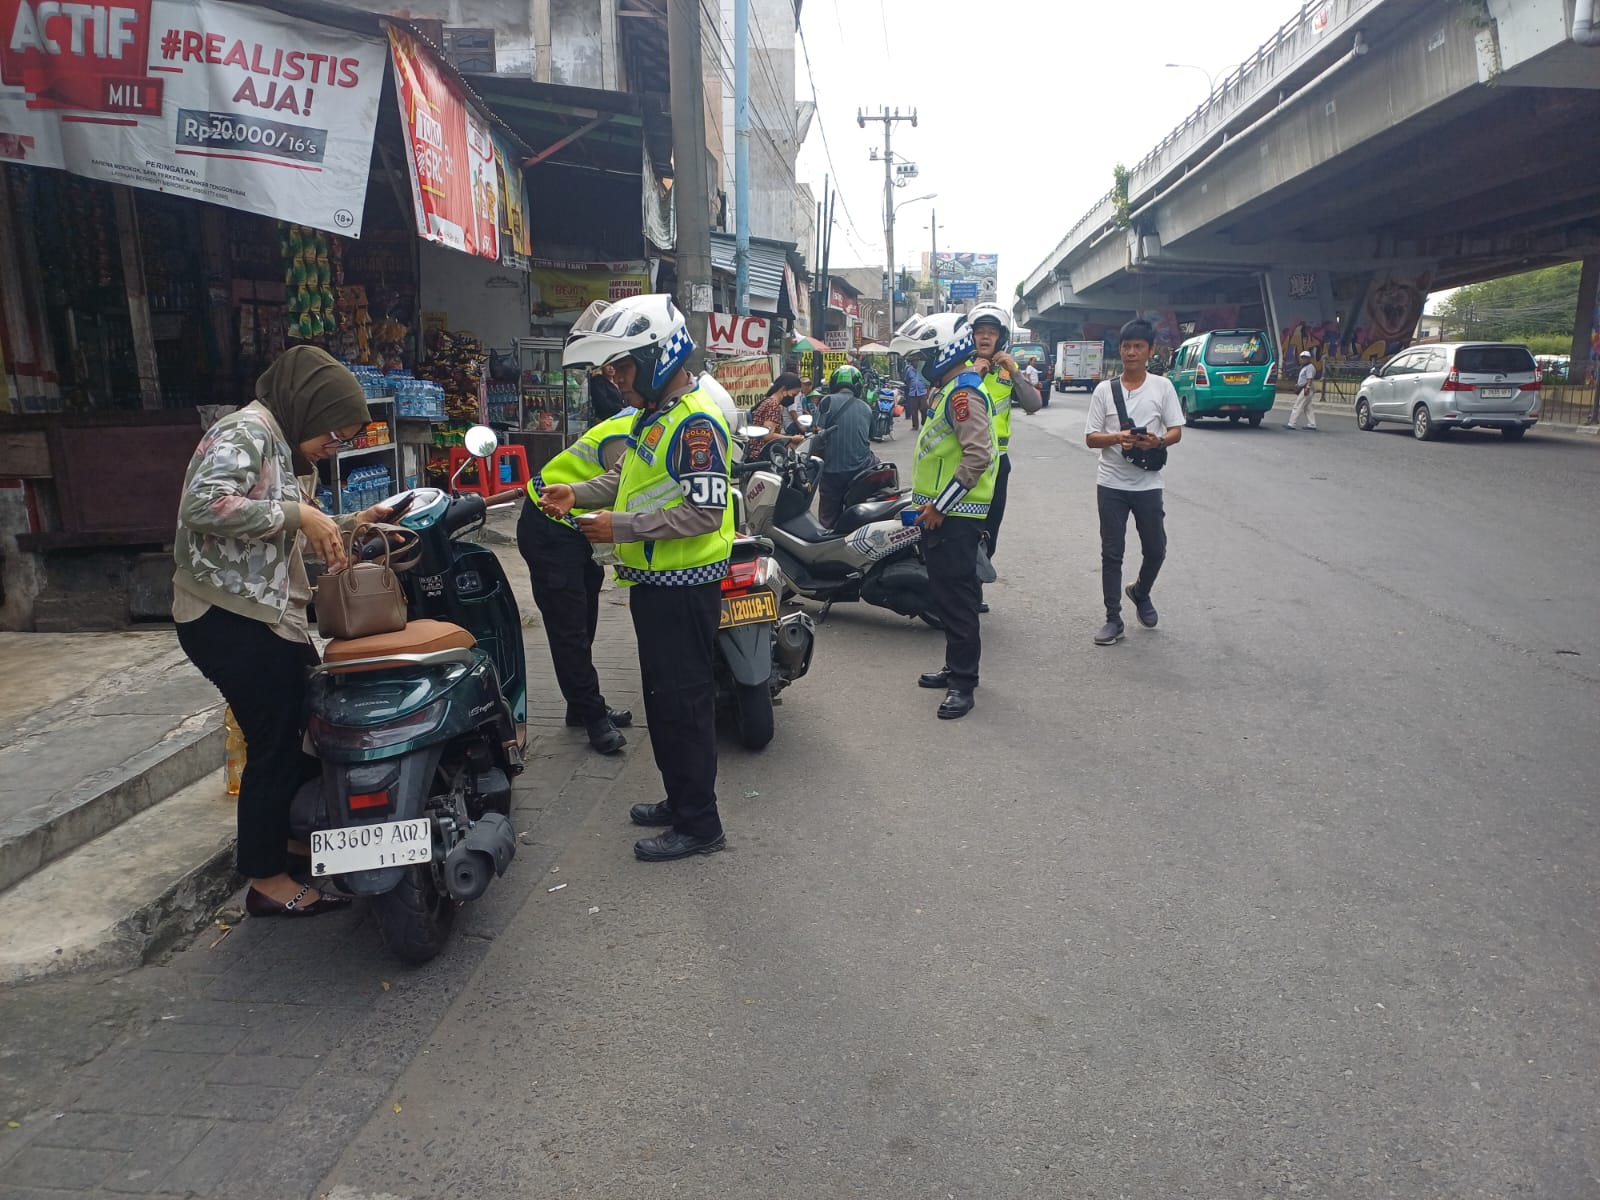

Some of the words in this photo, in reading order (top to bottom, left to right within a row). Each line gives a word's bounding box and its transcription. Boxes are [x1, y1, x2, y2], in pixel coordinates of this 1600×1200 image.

[9, 1, 138, 59] ACTIF
[160, 28, 360, 89] #REALISTIS
[232, 75, 314, 117] AJA!
[420, 111, 441, 147] TOKO
[426, 148, 444, 185] SRC
[336, 213, 351, 224] 18+
[708, 312, 767, 349] WC
[680, 477, 727, 505] PJR
